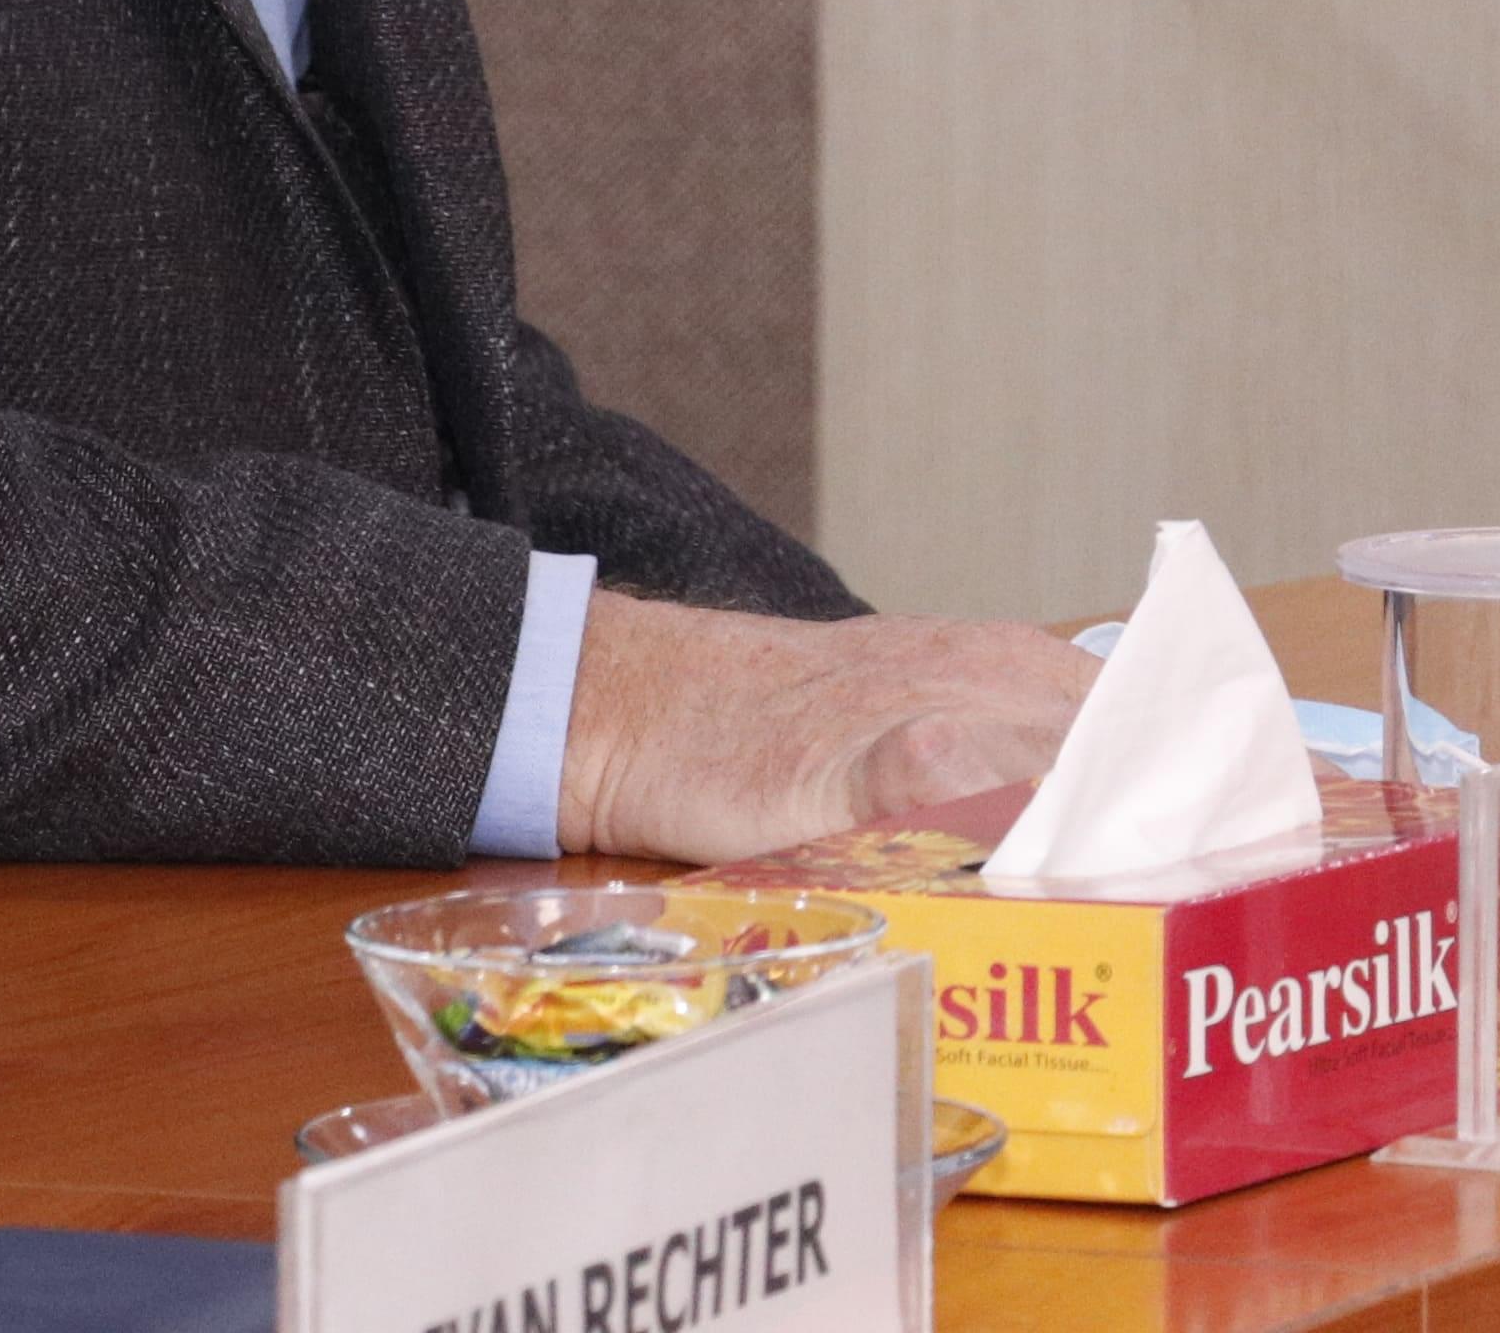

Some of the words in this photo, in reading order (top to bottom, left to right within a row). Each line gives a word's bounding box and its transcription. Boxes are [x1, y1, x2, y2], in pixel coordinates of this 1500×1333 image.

[937, 961, 1110, 1048] silk
[1183, 909, 1458, 1079] Pearsilk
[978, 1049, 1029, 1069] Facial
[581, 1179, 829, 1333] RECHTER
